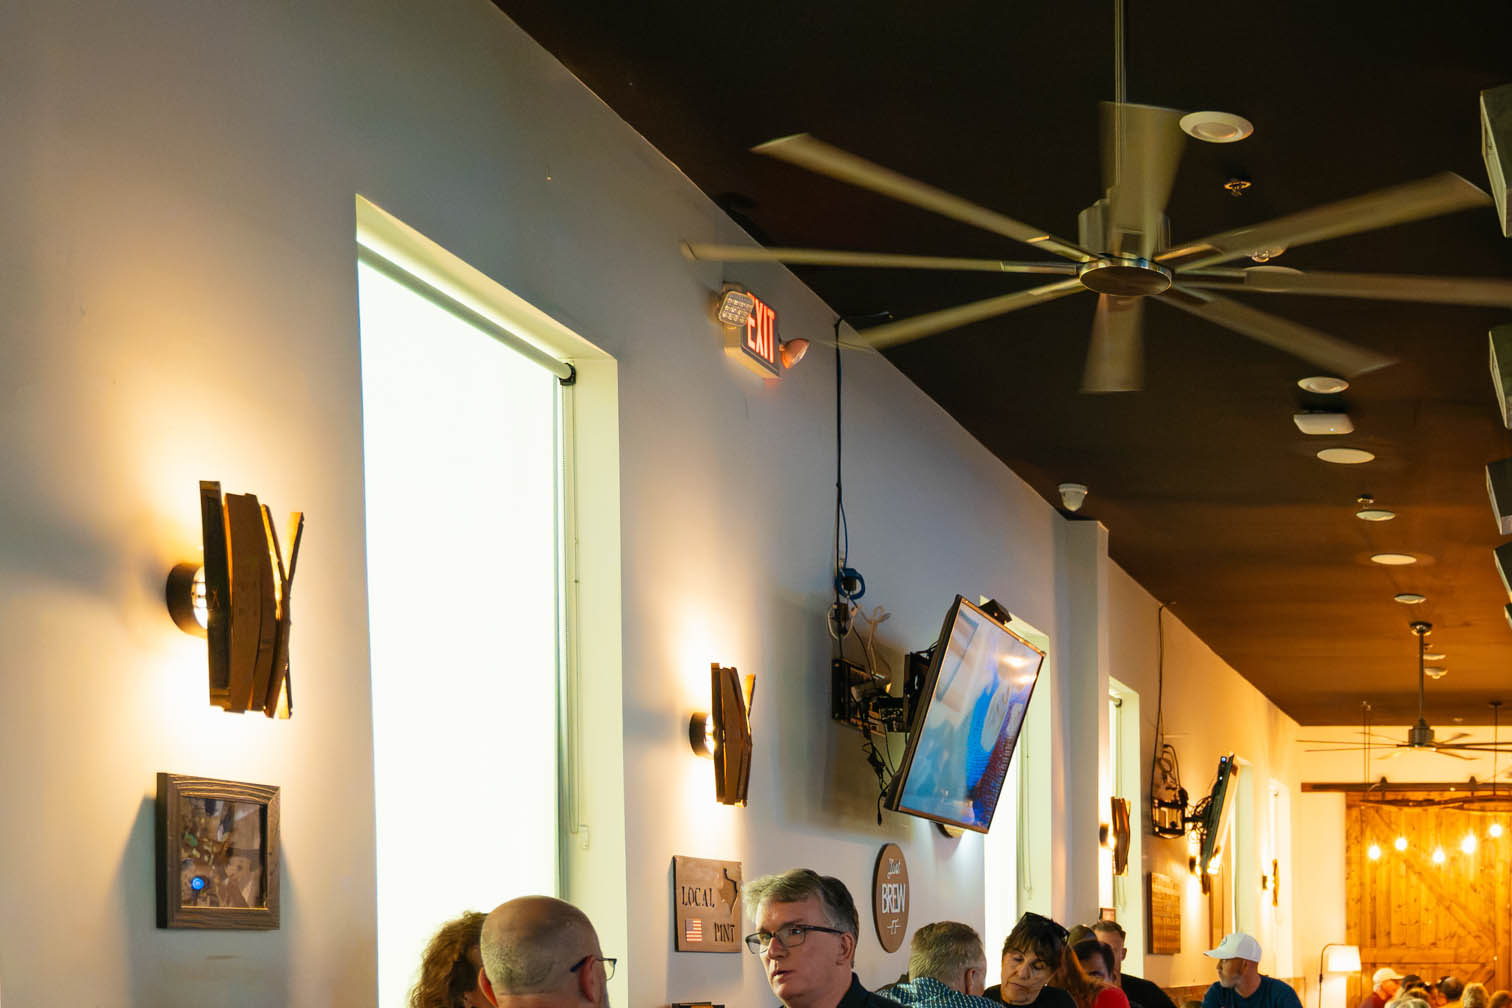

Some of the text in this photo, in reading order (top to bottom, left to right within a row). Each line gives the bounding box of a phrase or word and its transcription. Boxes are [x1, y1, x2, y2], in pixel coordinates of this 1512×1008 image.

[747, 292, 776, 364] EXIT
[681, 886, 715, 909] LOCAL
[882, 883, 906, 913] BREW
[713, 922, 736, 943] PINT
